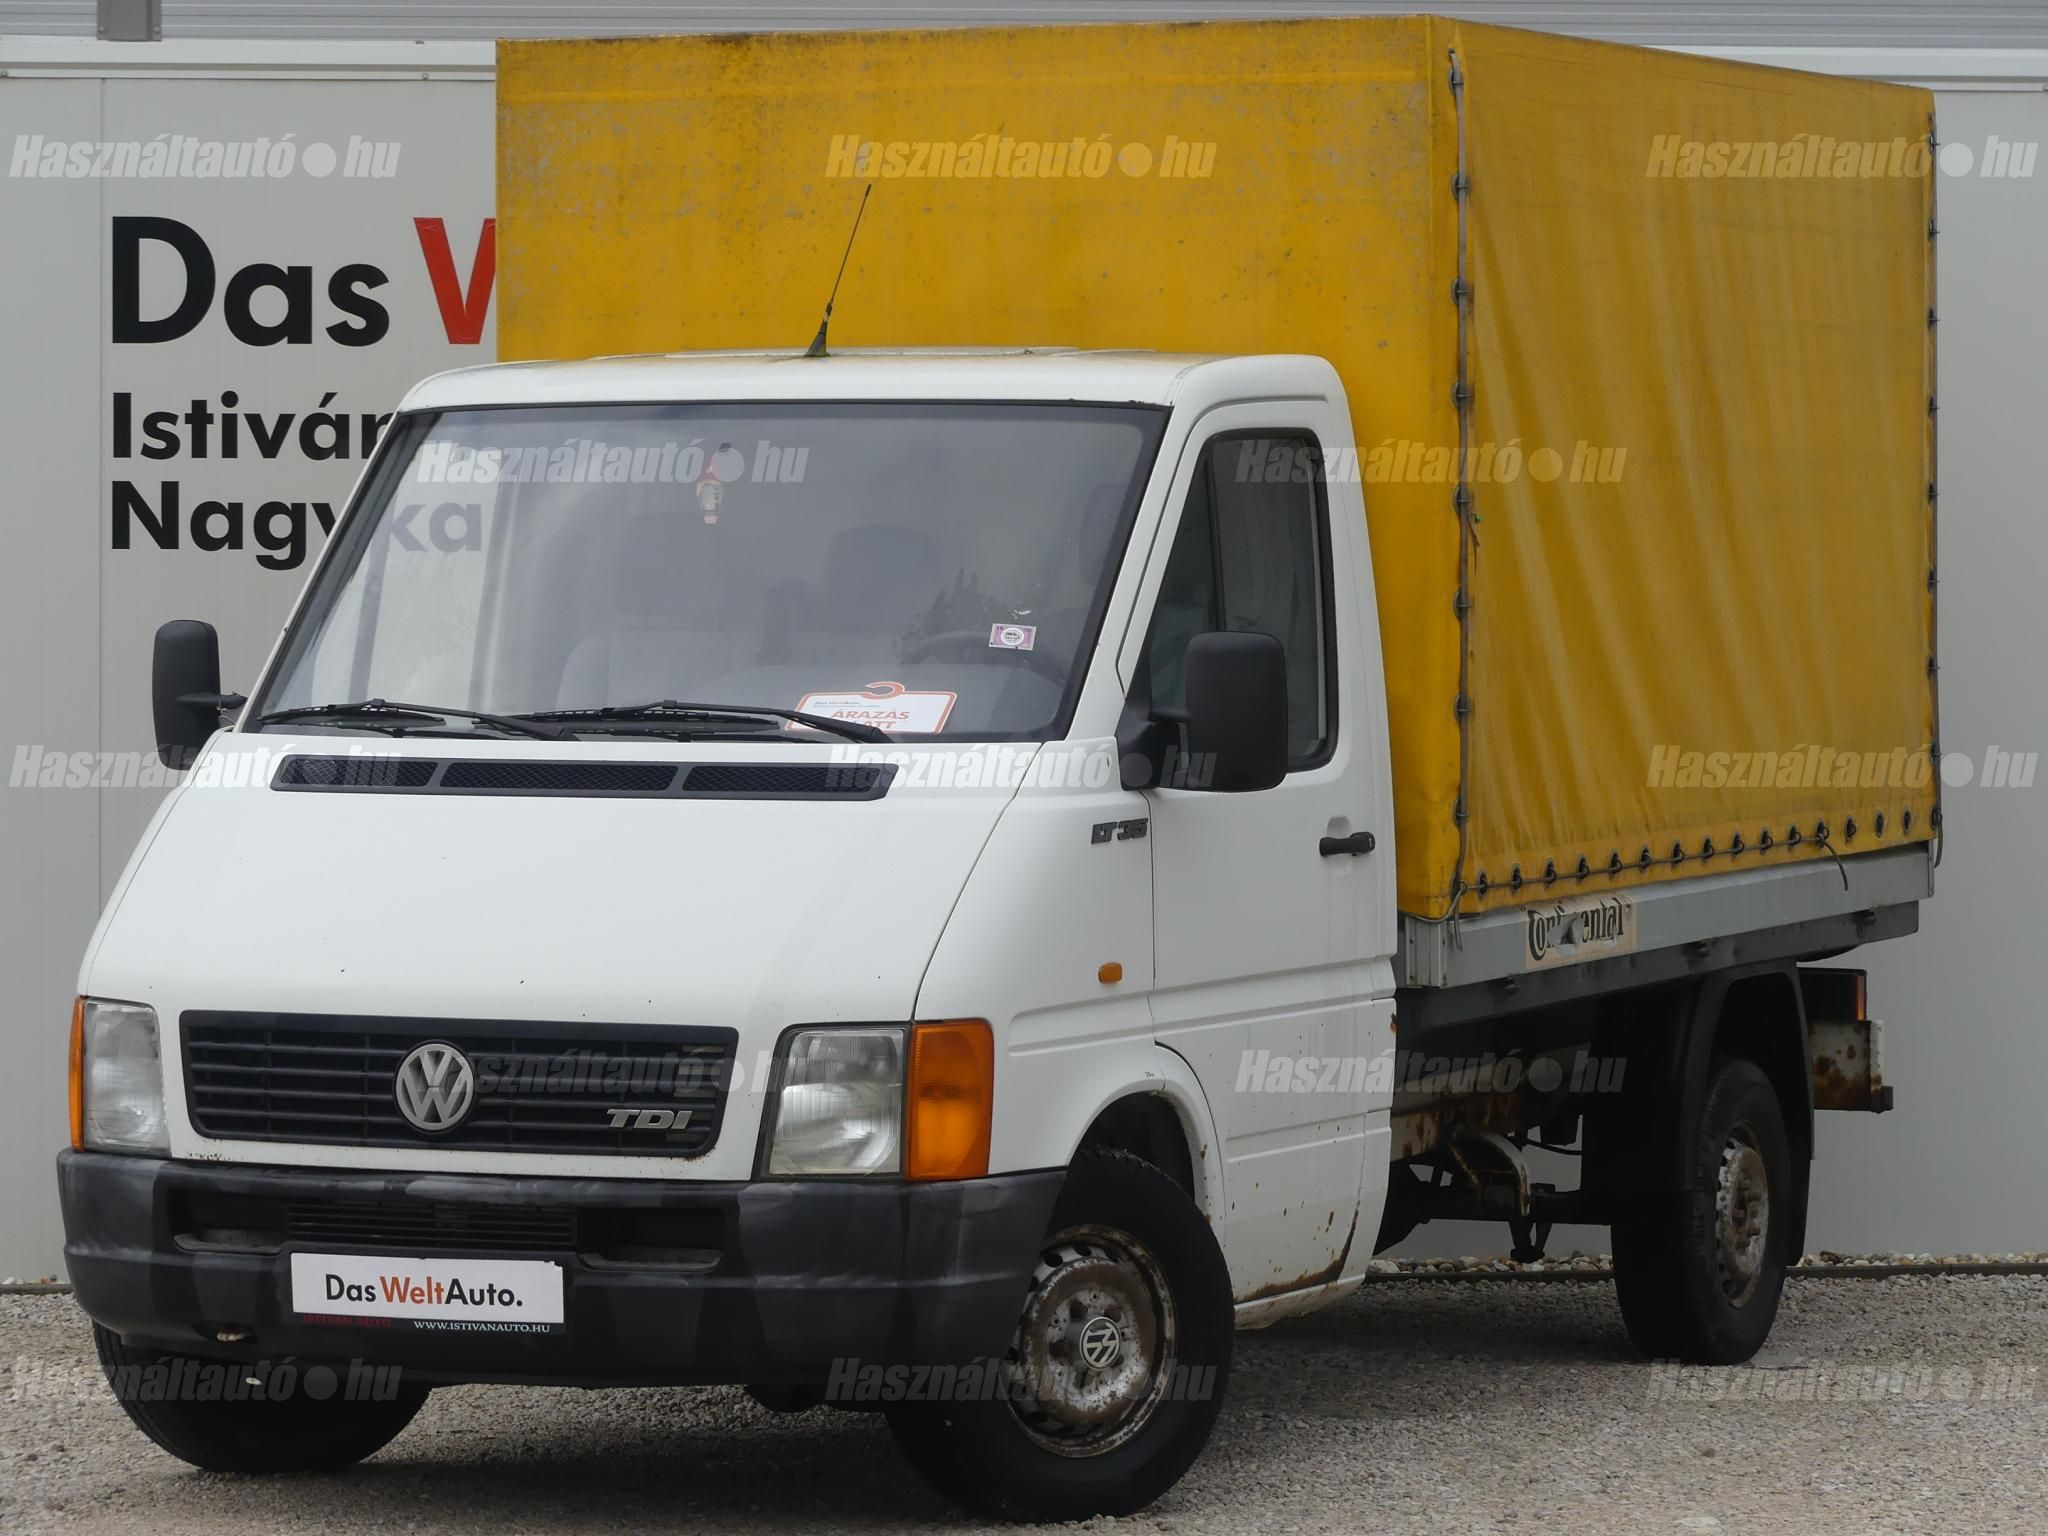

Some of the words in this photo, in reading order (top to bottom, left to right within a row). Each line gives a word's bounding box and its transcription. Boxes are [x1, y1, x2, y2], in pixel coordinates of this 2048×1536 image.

[111, 216, 391, 347] Das
[606, 1109, 693, 1130] TDI
[325, 1273, 376, 1302] Das
[380, 1276, 523, 1307] WeltAuto.
[414, 1320, 550, 1333] WWW.ISTIVANAUTO.HU
